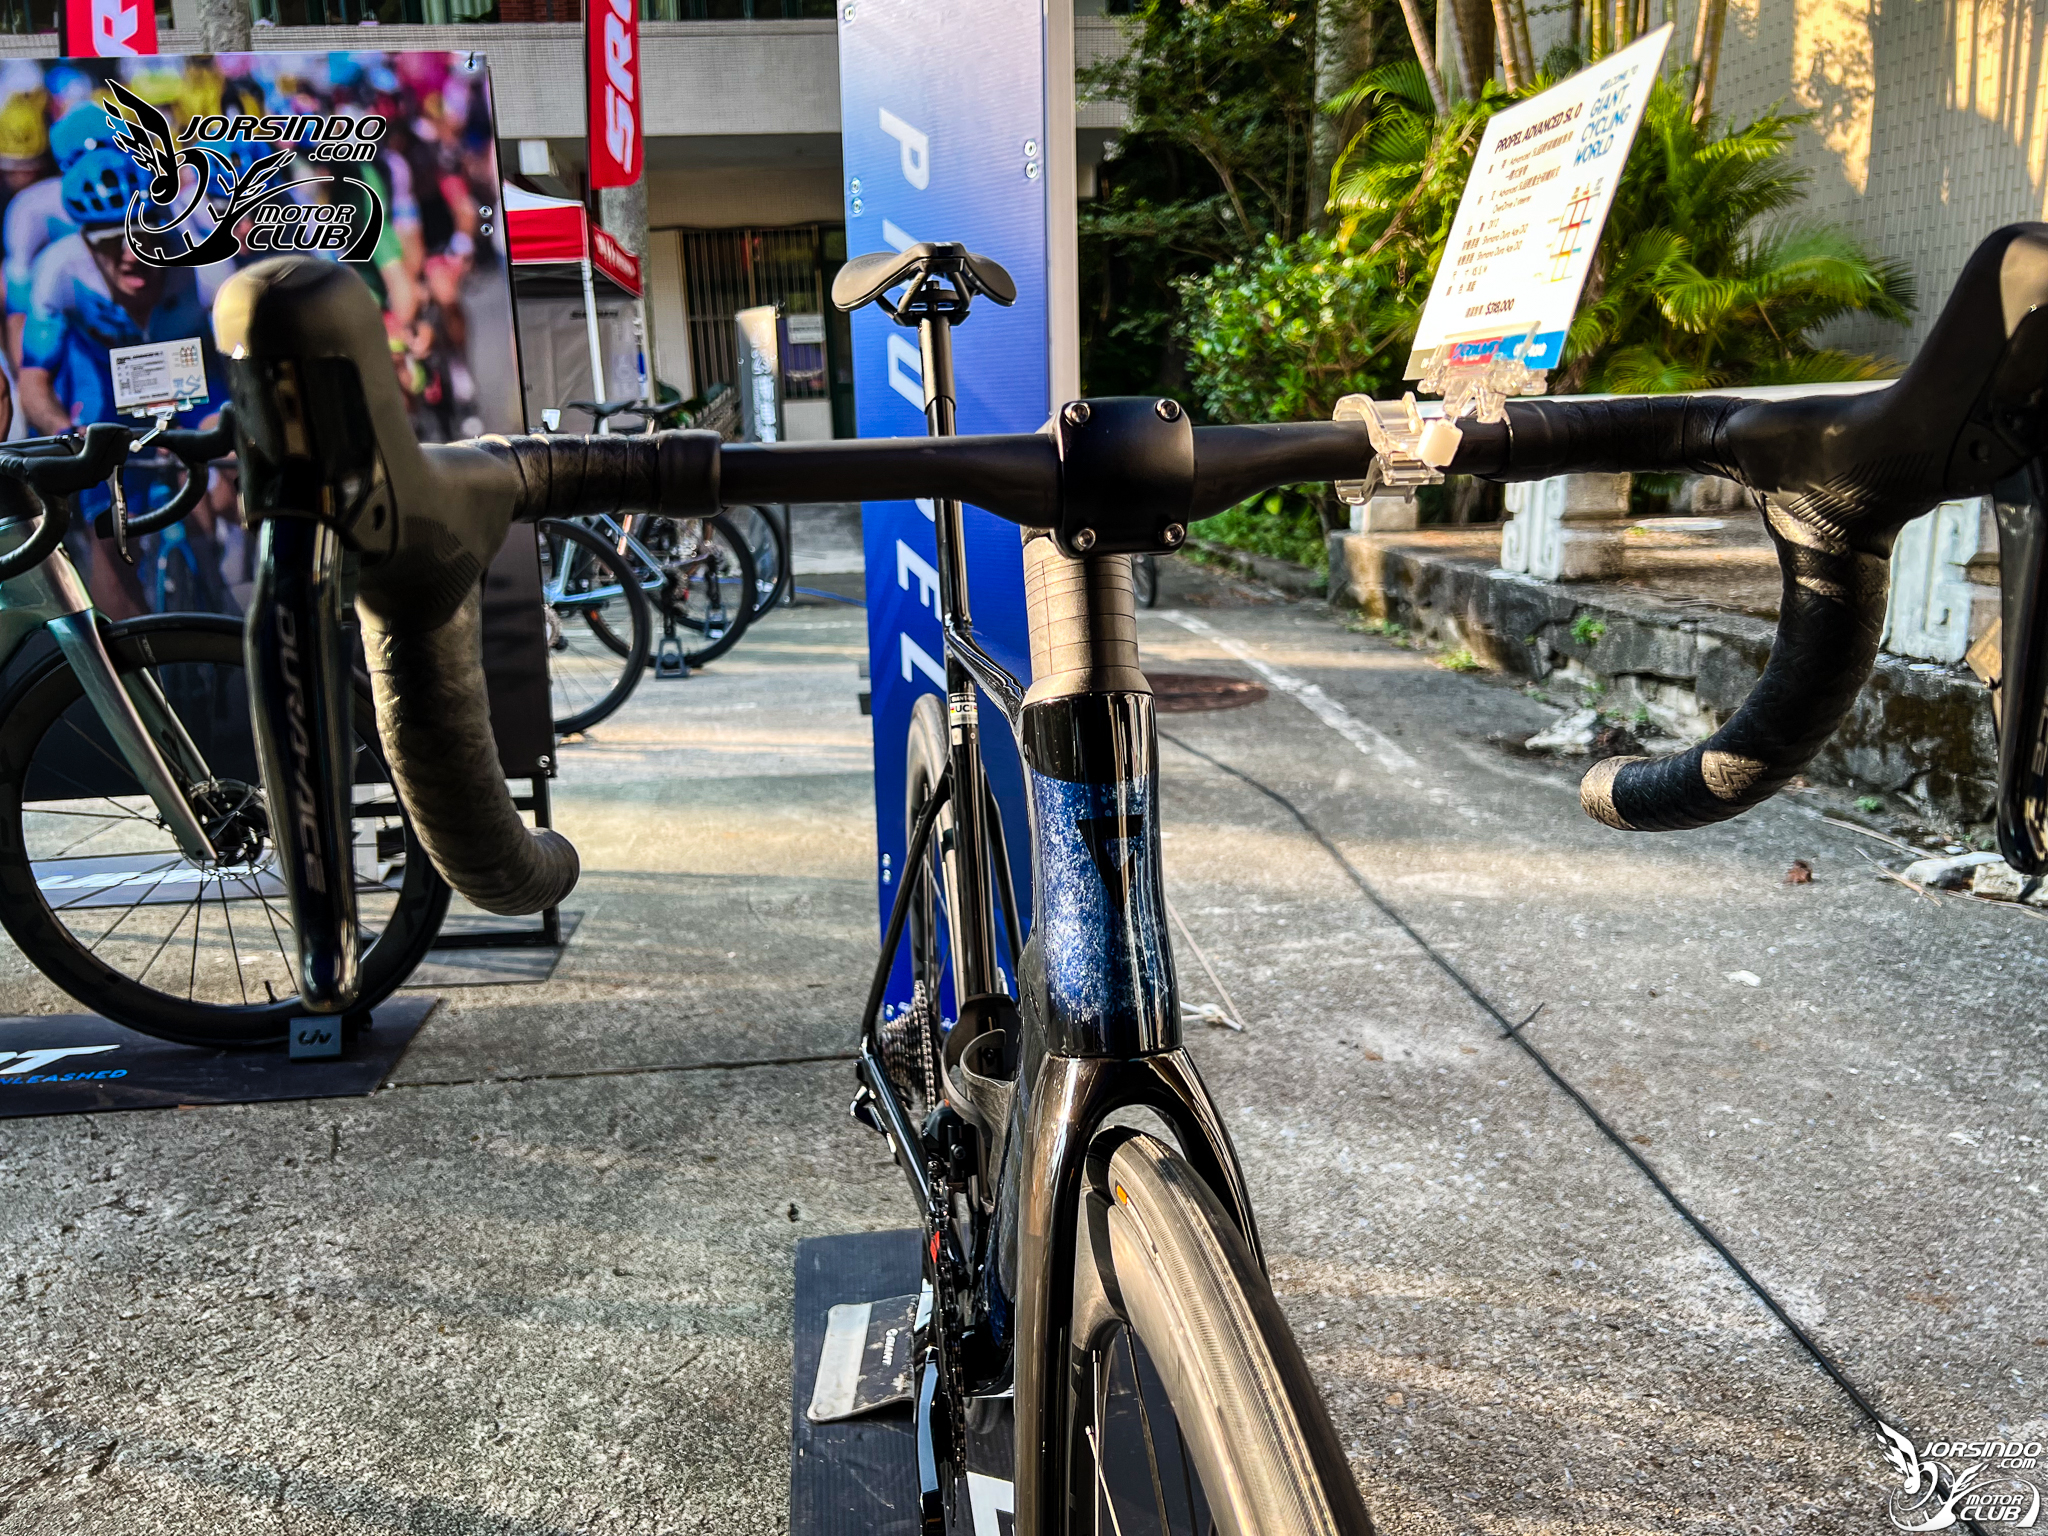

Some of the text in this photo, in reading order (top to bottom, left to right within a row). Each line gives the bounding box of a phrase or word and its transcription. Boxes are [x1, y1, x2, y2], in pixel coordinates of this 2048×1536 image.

[603, 0, 635, 174] SR
[1590, 83, 1630, 118] GIANT
[1494, 130, 1523, 154] PROPEL
[1521, 111, 1564, 143] ADVANCED
[1562, 106, 1574, 124] SL
[1581, 103, 1631, 143] CYCLING
[1573, 133, 1614, 168] WORLD
[274, 603, 326, 894] DURA-ACE
